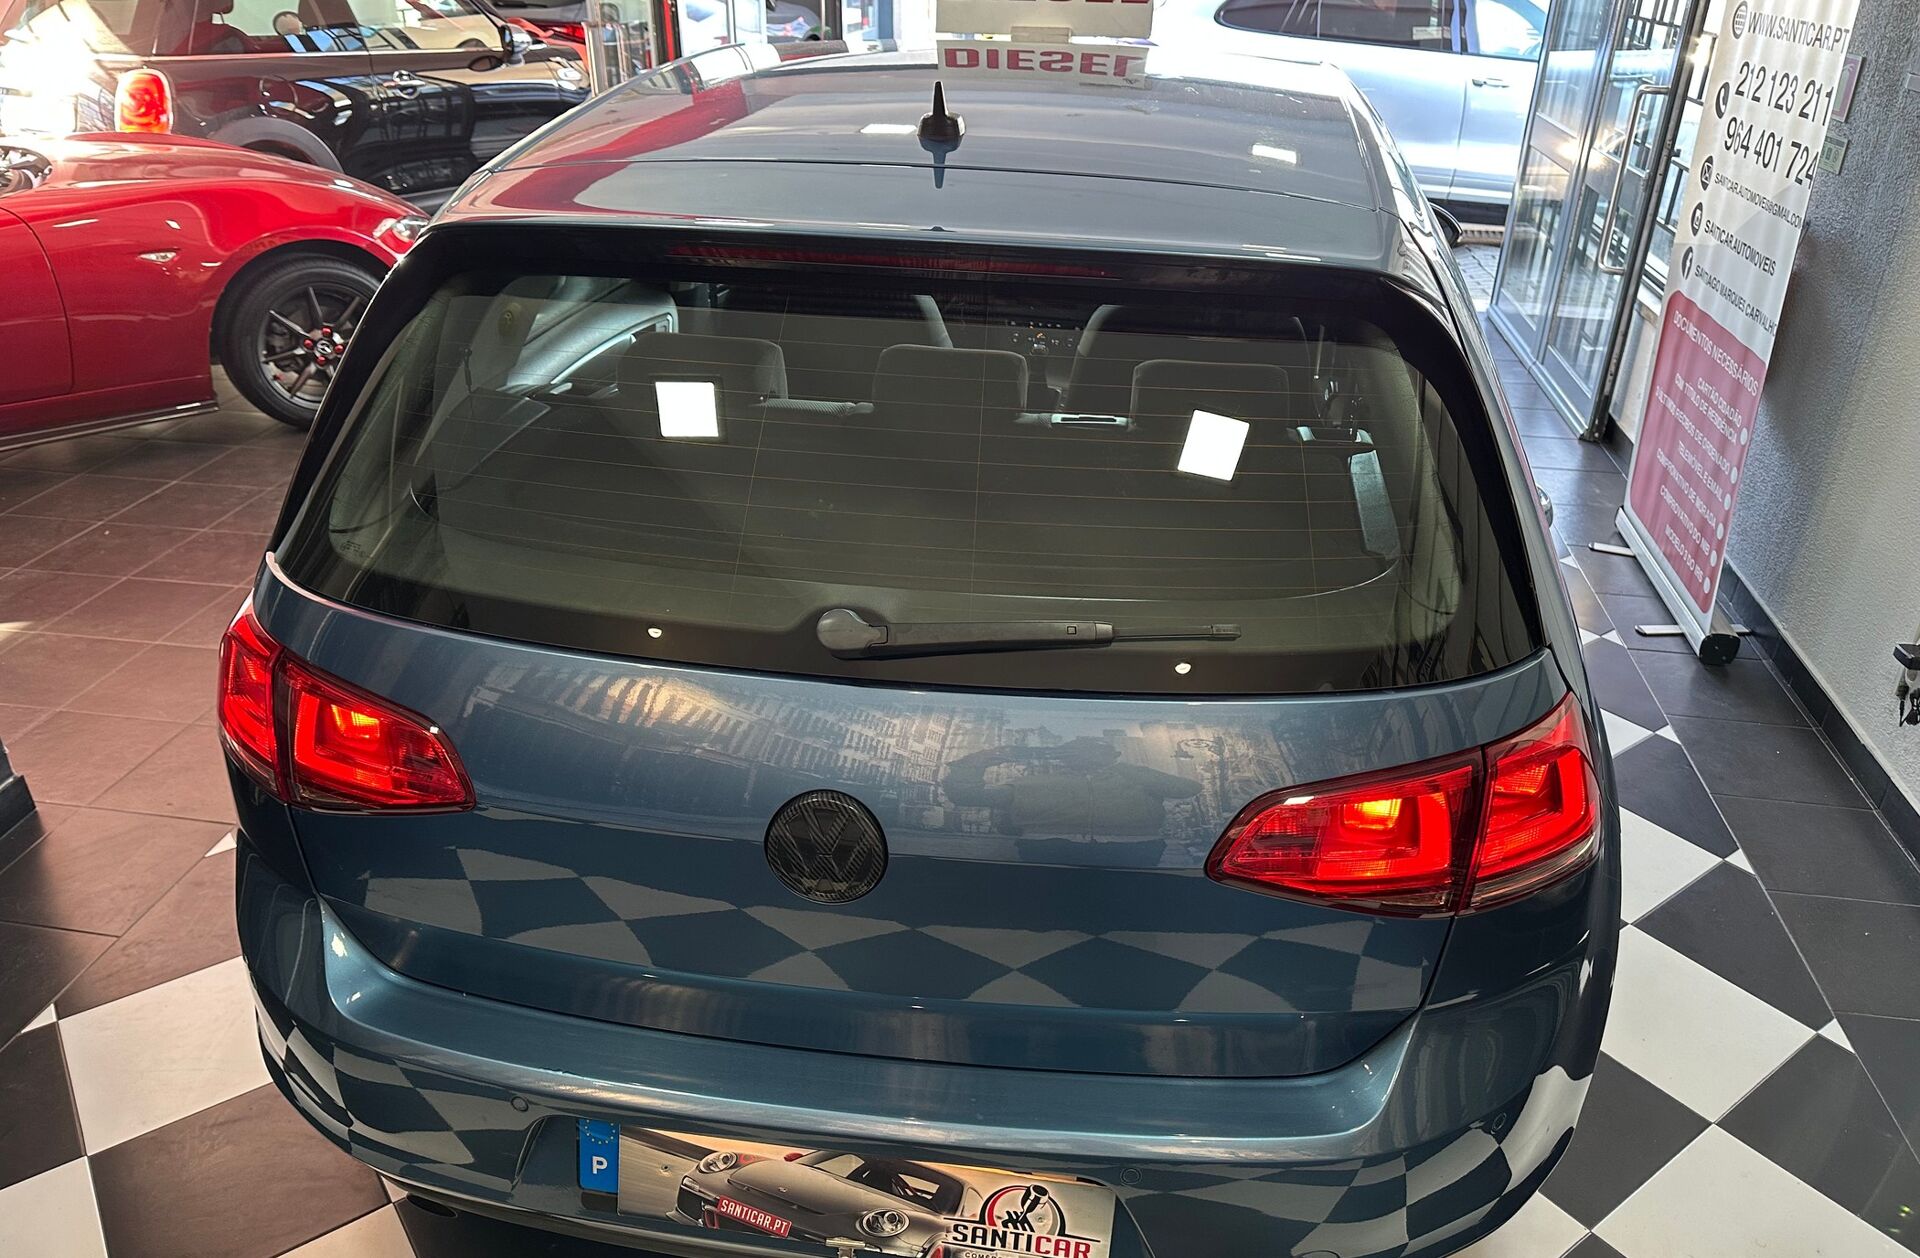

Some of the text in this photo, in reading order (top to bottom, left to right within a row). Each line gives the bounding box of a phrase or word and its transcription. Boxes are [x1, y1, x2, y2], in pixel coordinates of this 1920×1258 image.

[1748, 11, 1850, 54] WWW.SANTICAR.PT
[1735, 61, 1834, 126] 212 123 211
[1724, 117, 1753, 159] 964
[1753, 129, 1783, 172] 401
[1785, 140, 1819, 190] 724
[1720, 281, 1745, 312] MARQUES
[1673, 310, 1759, 397] DOCUMENTOS NECESSÁRIOS
[1697, 377, 1742, 428] CARTÃO CIDADÃO
[1699, 399, 1708, 415] DE
[1707, 406, 1737, 445] RESIDÊNCIA
[1694, 428, 1703, 446] DE
[1702, 437, 1730, 476] ORDENADO
[1688, 487, 1697, 504] DE
[1665, 524, 1685, 556] MODELO
[1686, 553, 1695, 571] DO
[1692, 527, 1702, 545] DO
[591, 1155, 608, 1175] P
[720, 1199, 788, 1234] SANTICAR.PT
[952, 1223, 1091, 1258] SANTICAR
